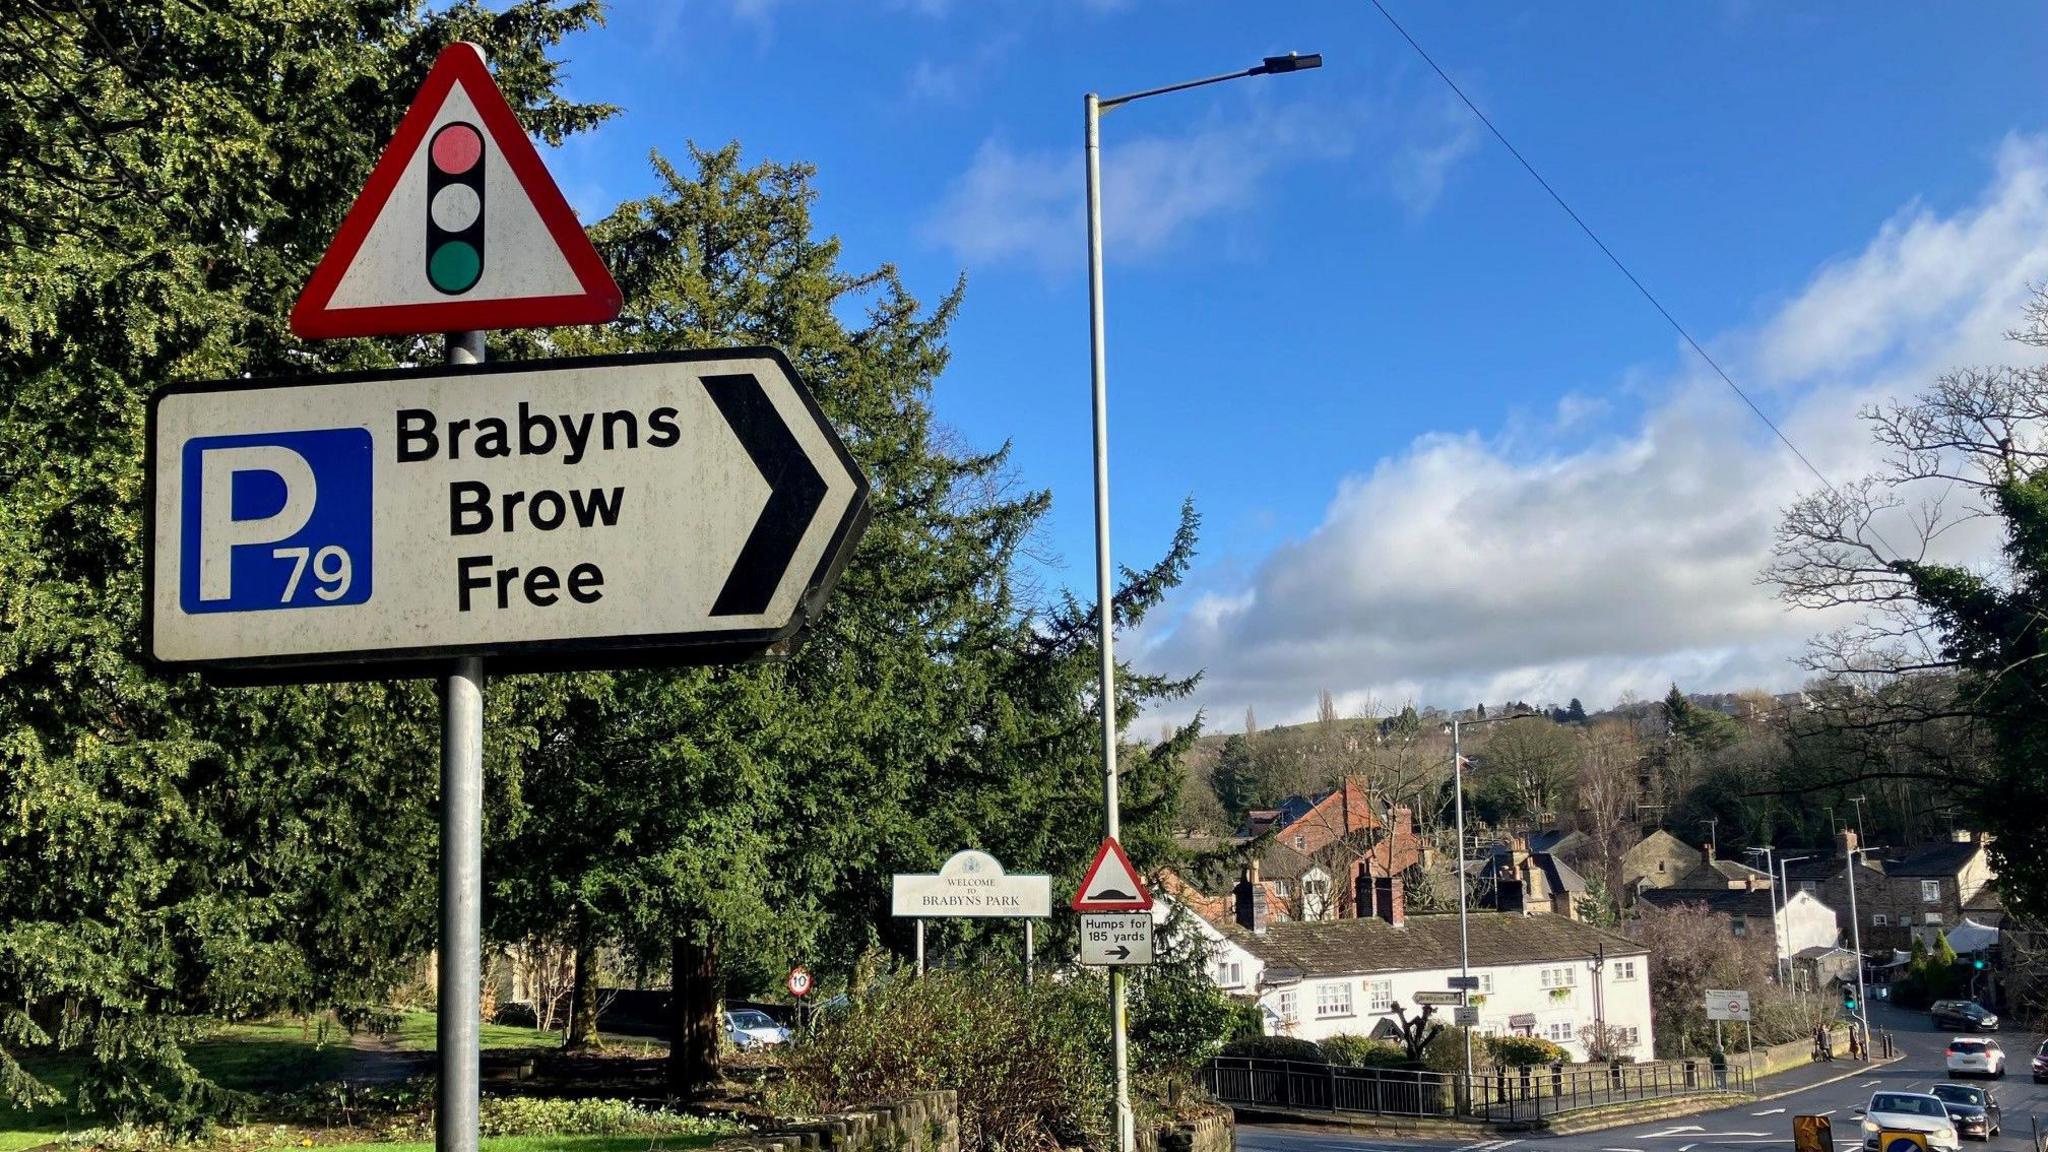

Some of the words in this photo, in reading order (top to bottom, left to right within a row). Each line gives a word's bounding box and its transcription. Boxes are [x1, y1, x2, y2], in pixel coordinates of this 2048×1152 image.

[396, 402, 681, 465] Brabyns
[199, 445, 317, 602] P
[450, 481, 625, 536] Brow
[273, 545, 352, 603] 79
[458, 555, 604, 612] Free
[947, 878, 996, 887] WELCOME
[922, 896, 981, 906] BRABYNS
[986, 896, 1020, 906] PARK
[1086, 919, 1124, 930] Humps
[1130, 919, 1147, 929] for
[1088, 931, 1108, 942] 185
[1113, 931, 1145, 943] yards
[794, 975, 806, 987] 10
